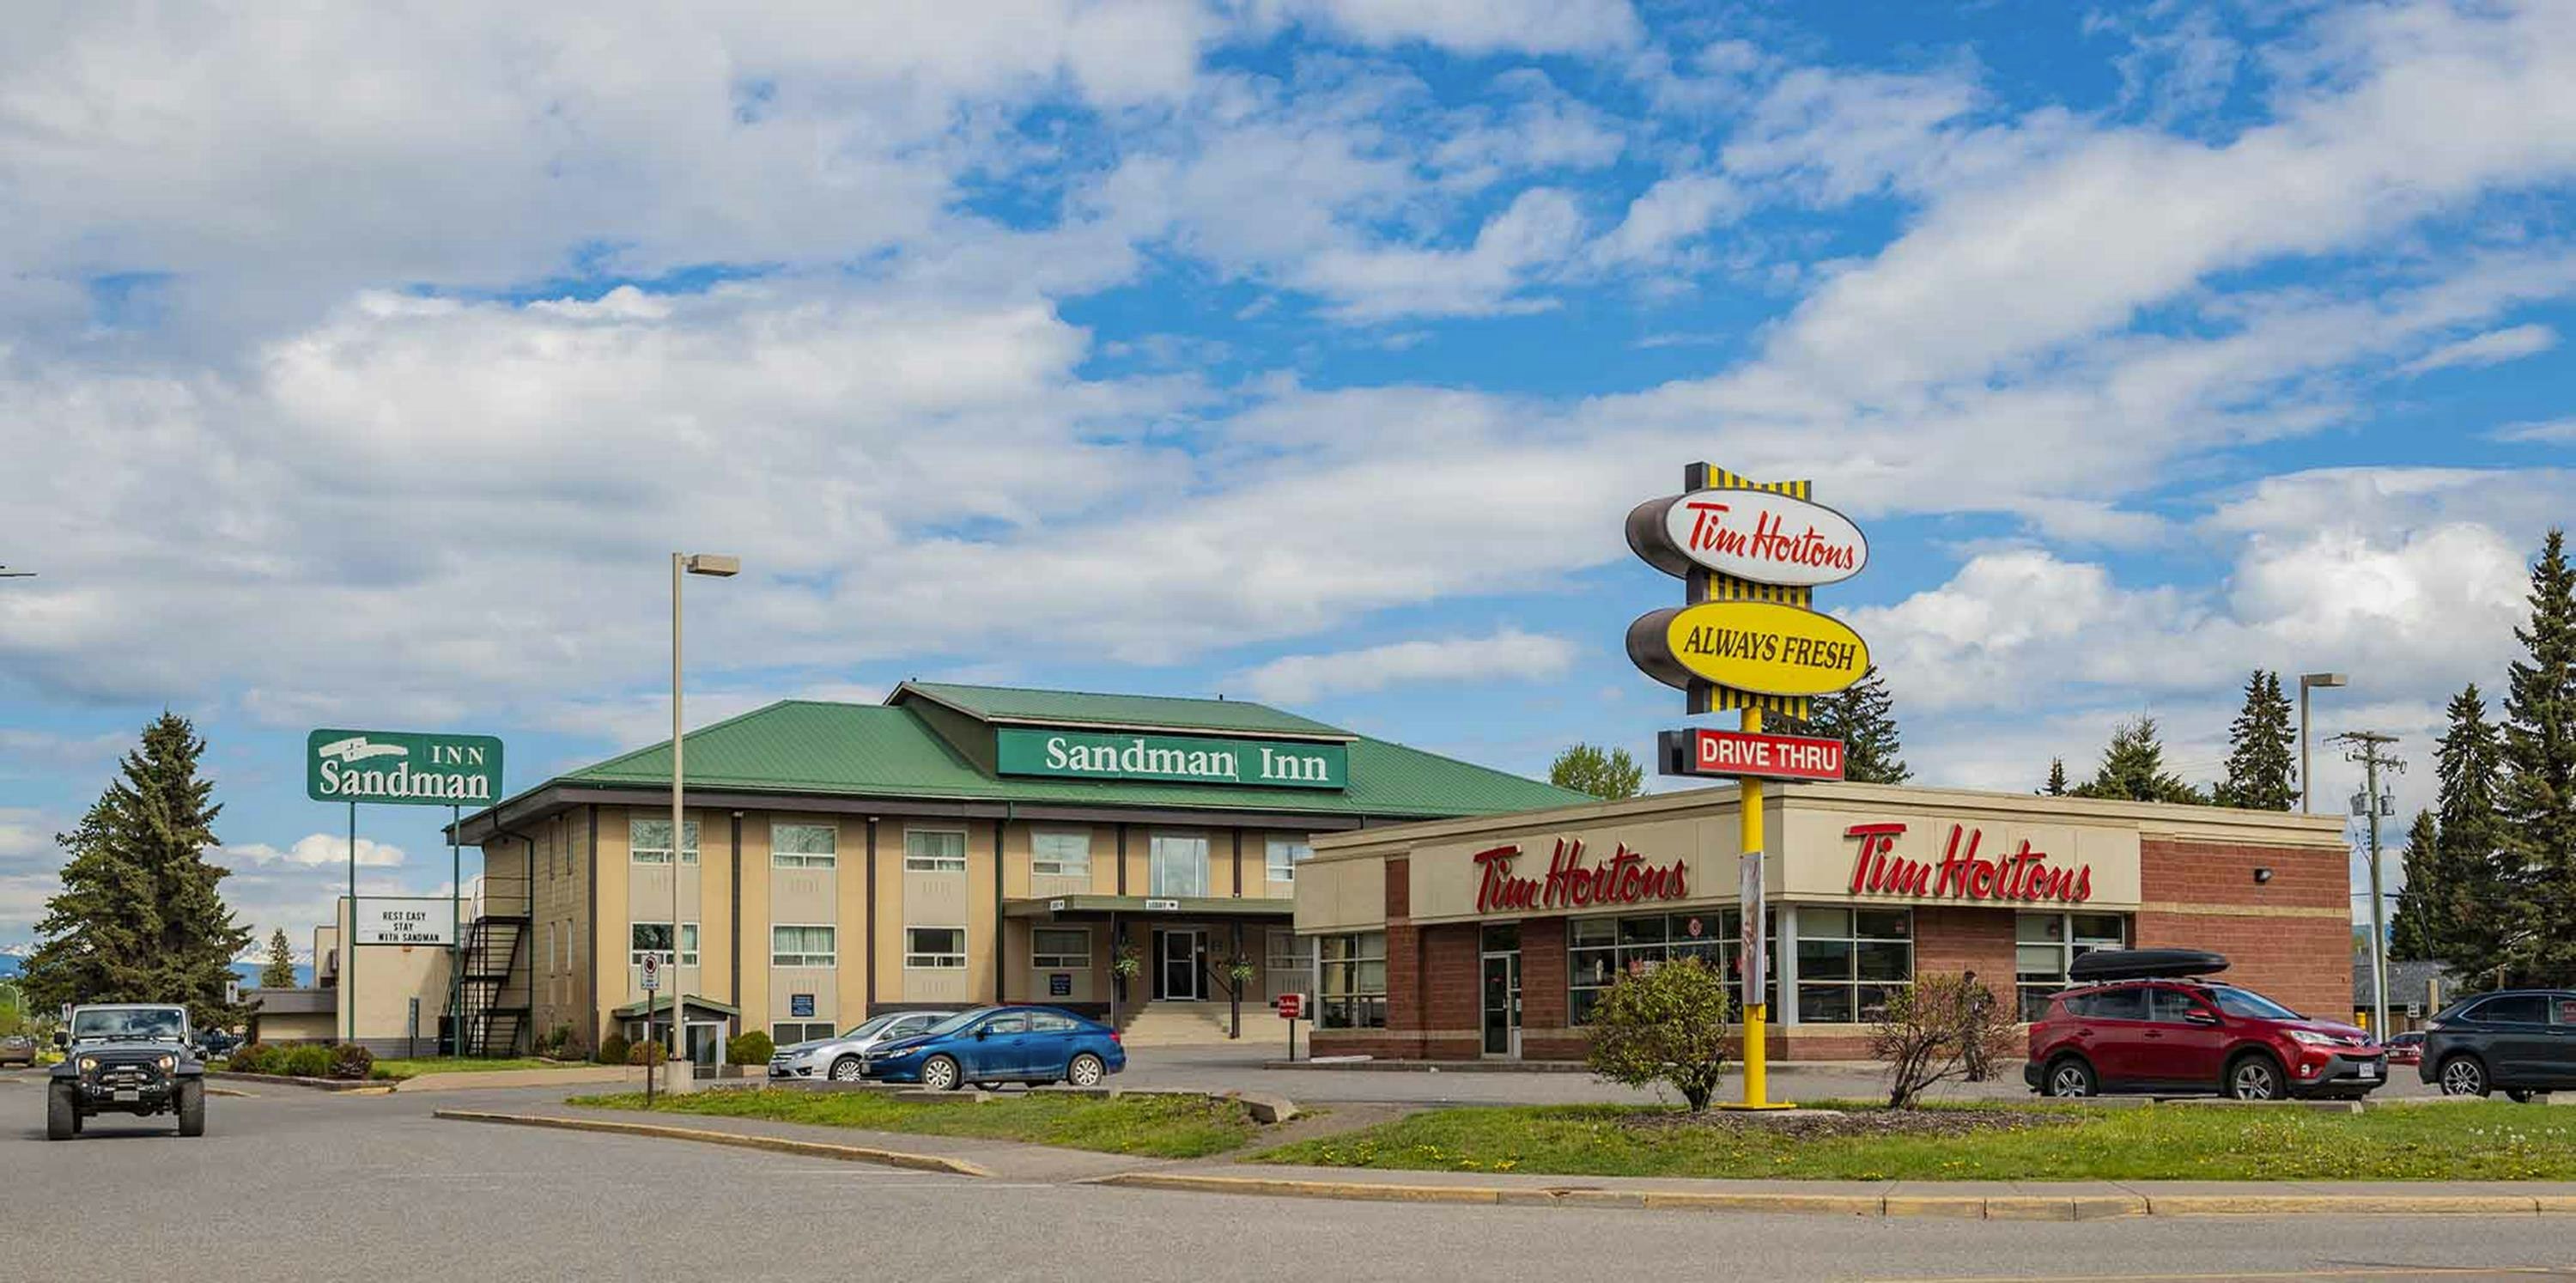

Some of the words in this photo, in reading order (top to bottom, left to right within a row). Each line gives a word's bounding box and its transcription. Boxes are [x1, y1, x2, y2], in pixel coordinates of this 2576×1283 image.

[1686, 502, 1747, 557] Tim
[1750, 510, 1855, 570] Hortons
[1684, 625, 1778, 661] ALWAYS
[1782, 635, 1856, 670] FRESH
[431, 745, 484, 765] INN
[1046, 737, 1236, 776] Sandman
[1259, 747, 1329, 781] Inn
[1702, 737, 1770, 767] DRIVE
[1776, 743, 1838, 771] THRU
[319, 760, 490, 800] Sandman
[1473, 845, 1540, 914] Tim
[1542, 837, 1689, 907] Hortons
[1845, 823, 1933, 897] Tim
[1933, 823, 2092, 902] Hortons
[383, 911, 404, 921] REST
[406, 911, 426, 921] EASY
[393, 922, 413, 931] STAY
[379, 933, 398, 941] WITH
[403, 933, 440, 942] SANDMAN
